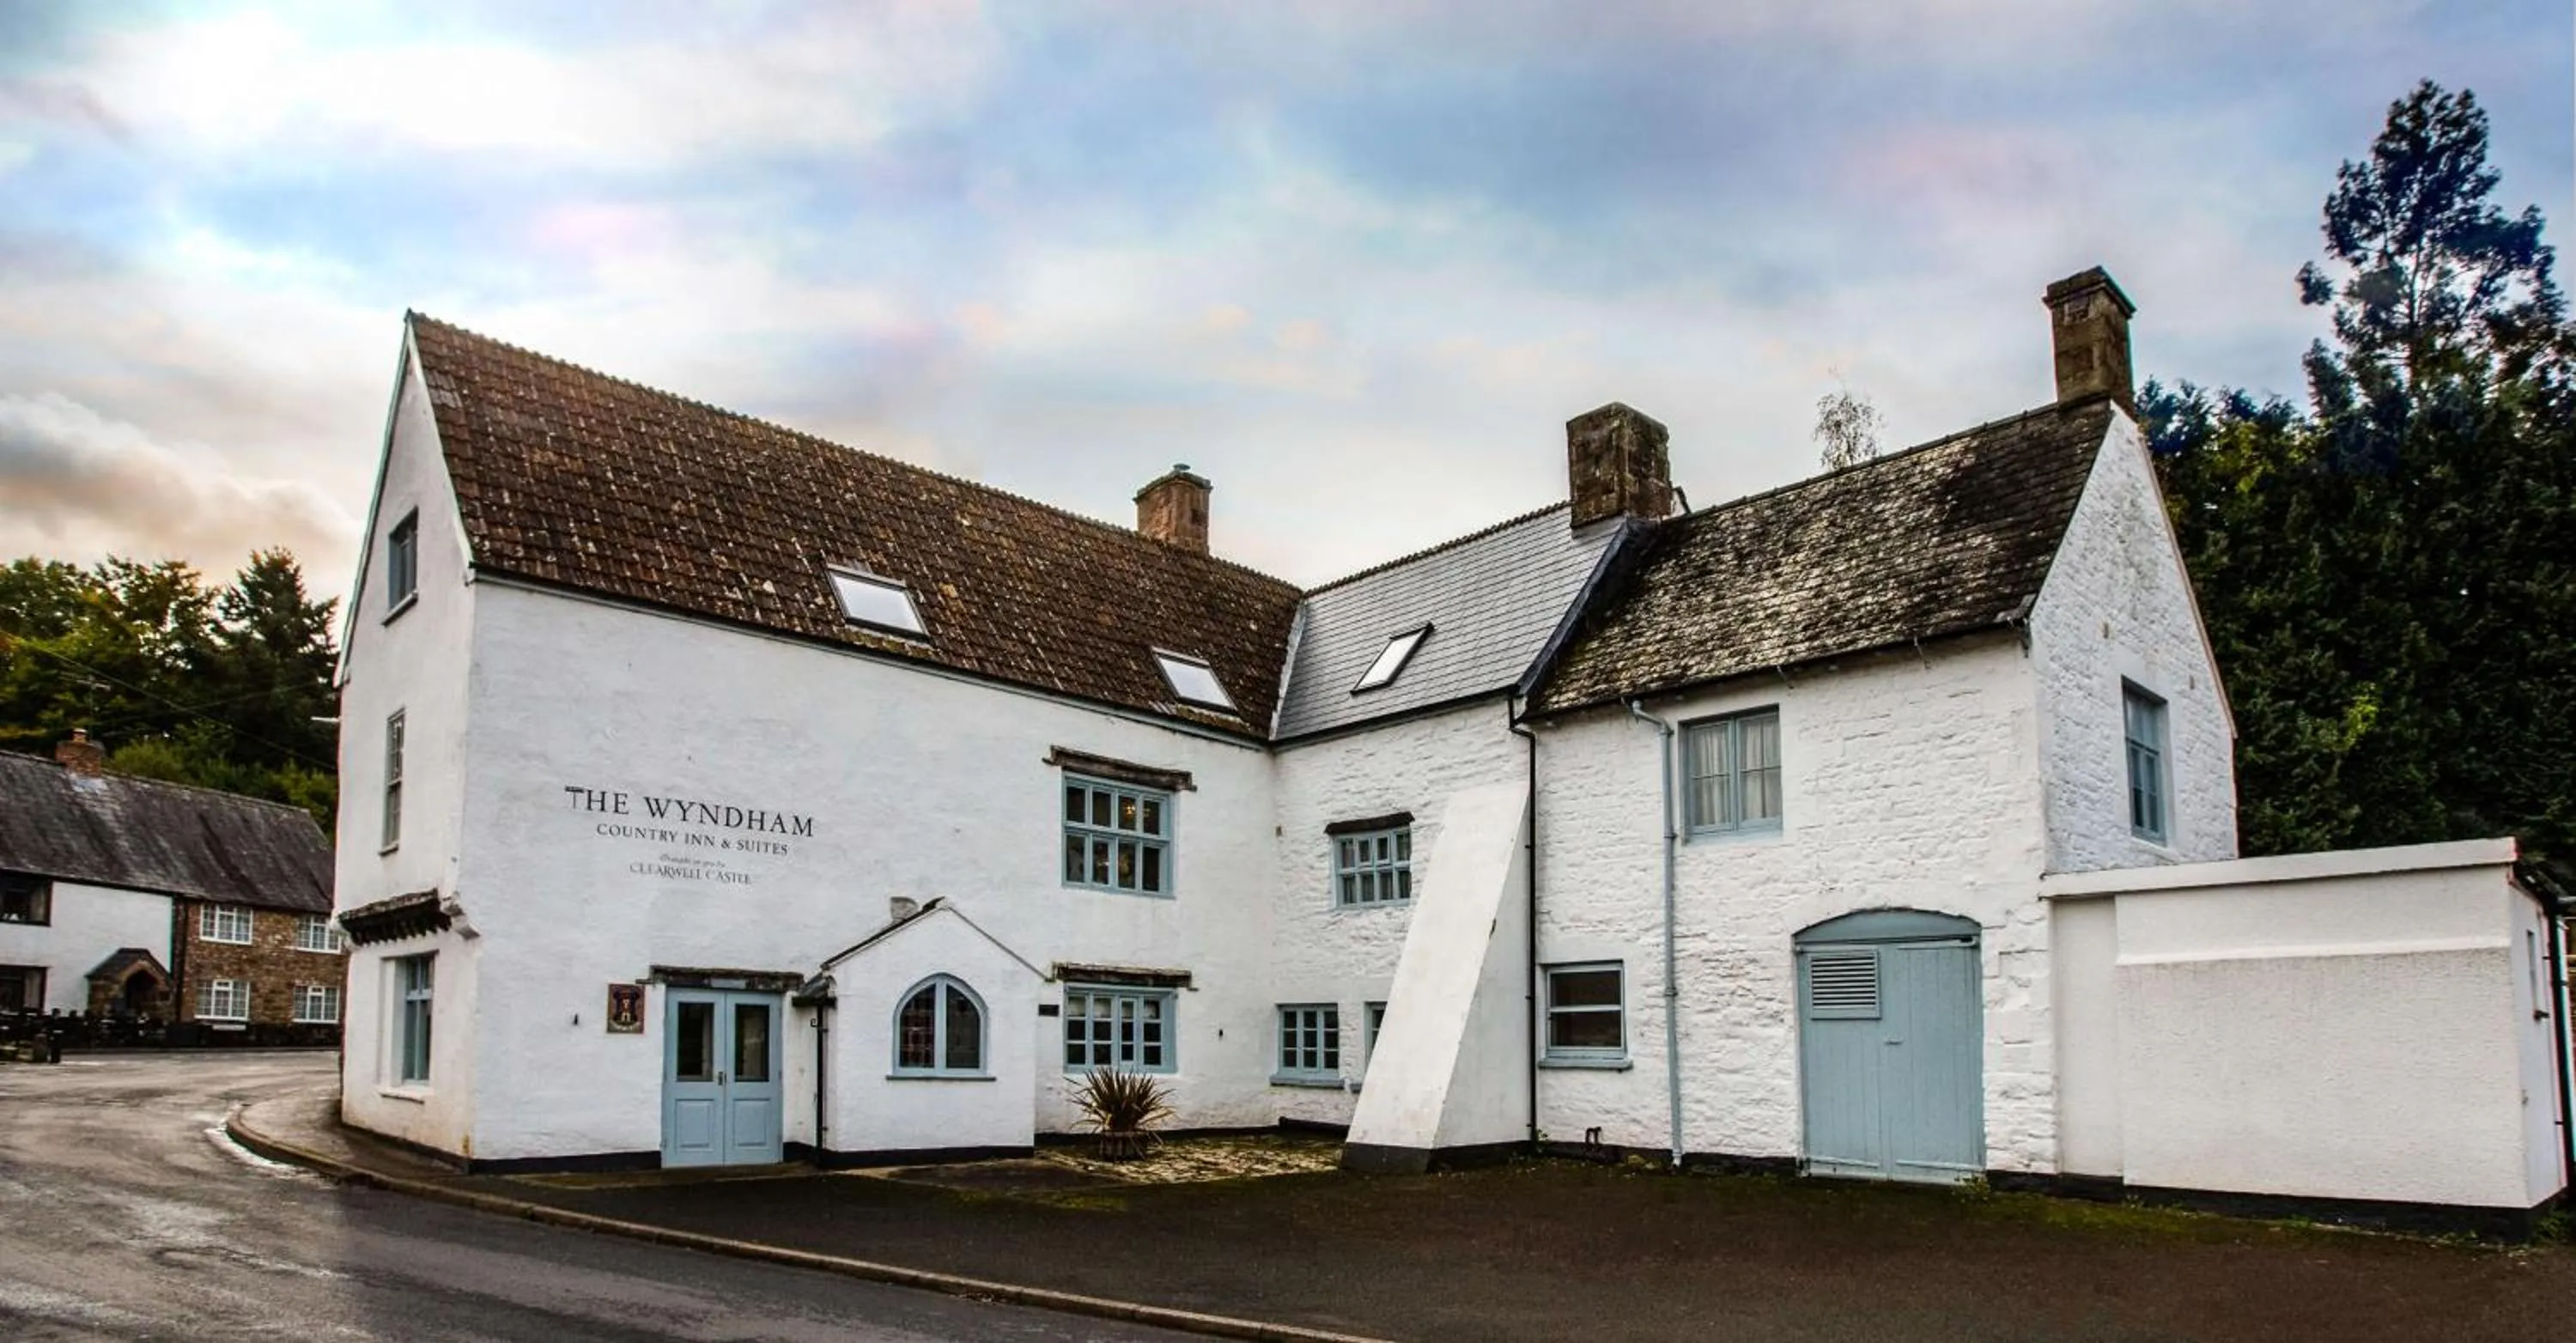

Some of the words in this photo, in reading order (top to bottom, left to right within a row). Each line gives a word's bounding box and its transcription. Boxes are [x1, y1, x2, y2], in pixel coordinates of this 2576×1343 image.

[564, 786, 629, 815] THE
[644, 796, 815, 837] WYNDHAM
[597, 823, 678, 843] COUNTRY
[684, 833, 716, 848] INN
[720, 837, 731, 849] &
[737, 839, 789, 856] SUITES
